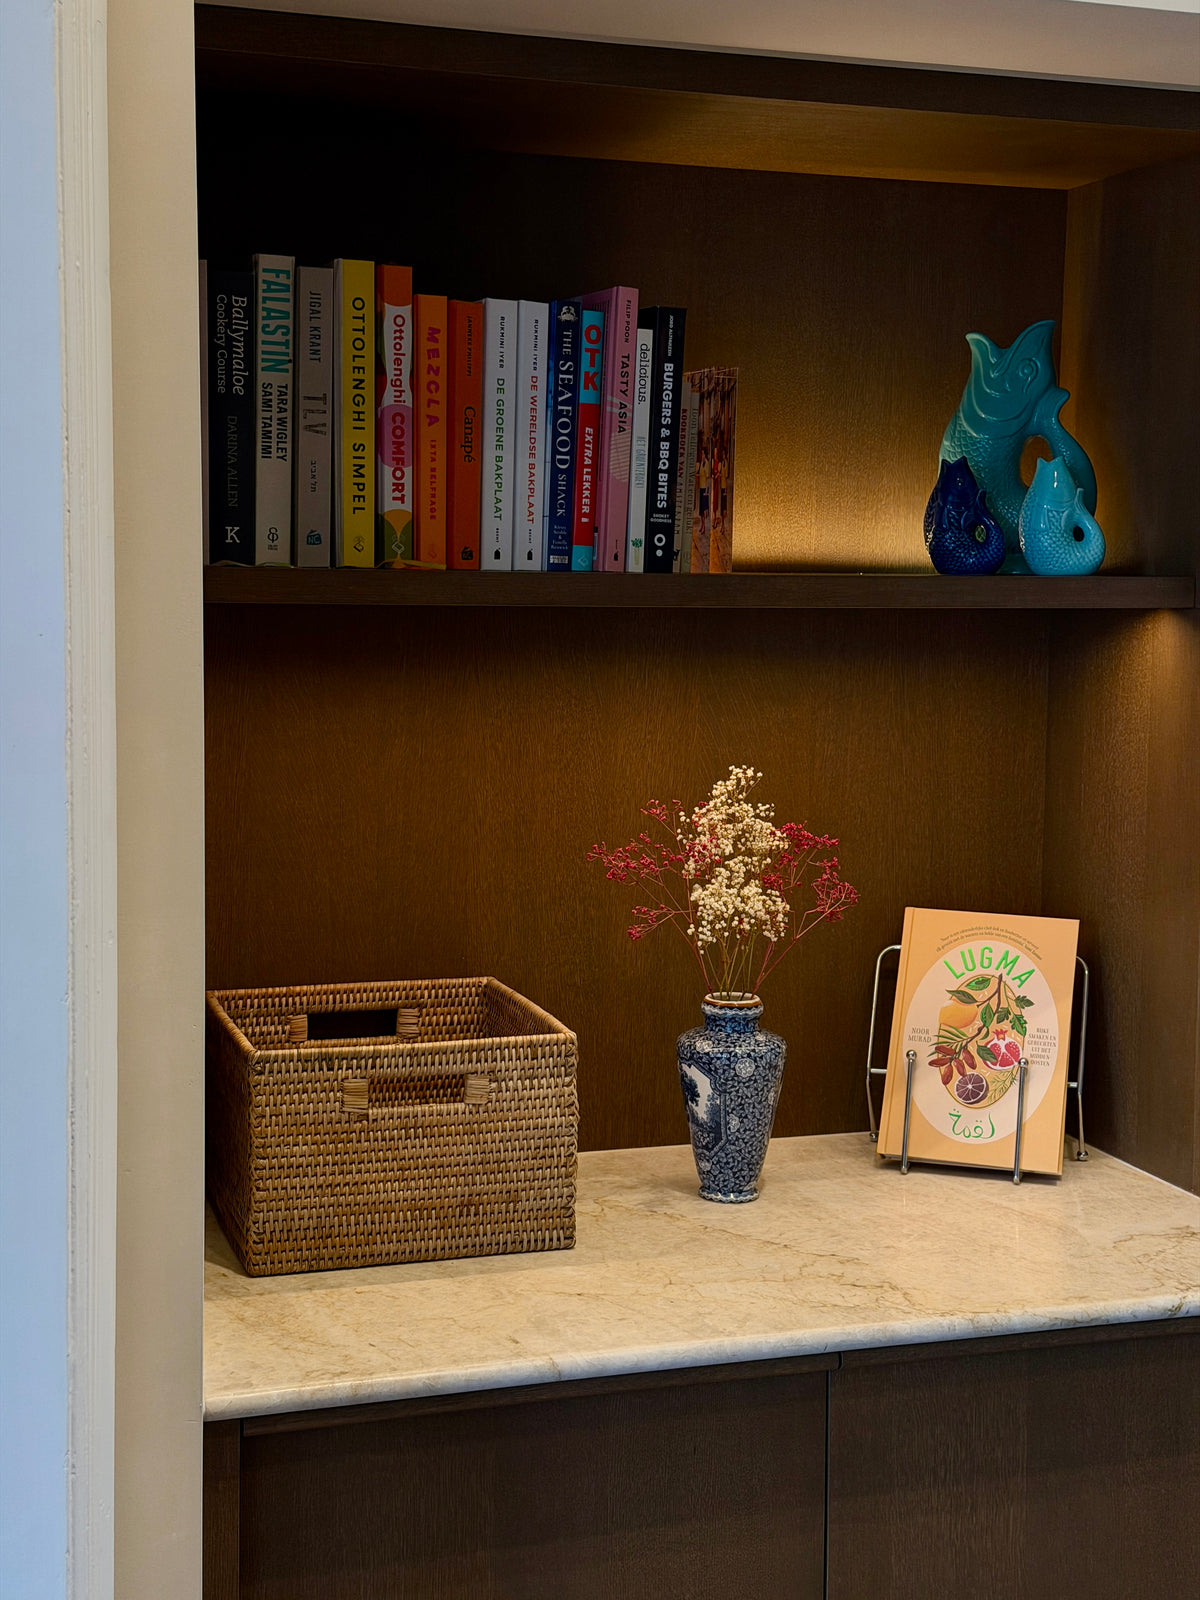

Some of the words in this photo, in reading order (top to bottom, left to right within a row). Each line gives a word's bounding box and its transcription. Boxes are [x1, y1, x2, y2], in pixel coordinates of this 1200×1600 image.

[214, 294, 229, 347] Cookery
[261, 268, 291, 374] FALASTIN
[309, 290, 321, 322] JIGAL
[227, 295, 249, 396] Ballymaloe
[309, 326, 321, 363] KRANT
[352, 297, 366, 430] OTTOLENGHI
[390, 314, 406, 404] Ottolenghi
[562, 329, 573, 355] THE
[583, 324, 602, 392] OTK
[217, 350, 228, 394] Course
[426, 326, 441, 427] MEZCLA
[497, 377, 505, 394] DE
[530, 375, 539, 391] DE
[619, 353, 630, 397] TASTY
[638, 343, 651, 405] delicious.
[661, 362, 674, 425] BURGERS
[261, 382, 273, 412] SAMI
[276, 383, 288, 414] TARA
[303, 393, 327, 436] TLV
[555, 360, 574, 470] SEAFOOD
[618, 401, 628, 434] ASIA
[227, 415, 239, 464] DARINA
[261, 415, 273, 459] TAMIMI
[276, 416, 288, 462] WIGLEY
[460, 406, 476, 463] Canapé
[495, 398, 505, 451] GROENE
[528, 395, 538, 459] WERELDSE
[583, 426, 594, 465] EXTRA
[660, 427, 671, 438] &
[391, 412, 406, 504] COMFORT
[657, 441, 670, 470] BBQ
[227, 467, 239, 508] ALLEN
[352, 442, 366, 515] SIMPEL
[494, 455, 504, 521] BAKPLAAT
[527, 462, 536, 524] BAKPLAAT
[556, 473, 567, 517] SHACK
[581, 467, 592, 514] LEKKER
[656, 472, 669, 509] BITES
[225, 526, 241, 544] K
[943, 946, 1036, 988] LUGMA
[908, 1034, 932, 1043] MURAD
[912, 1027, 930, 1035] NOOR
